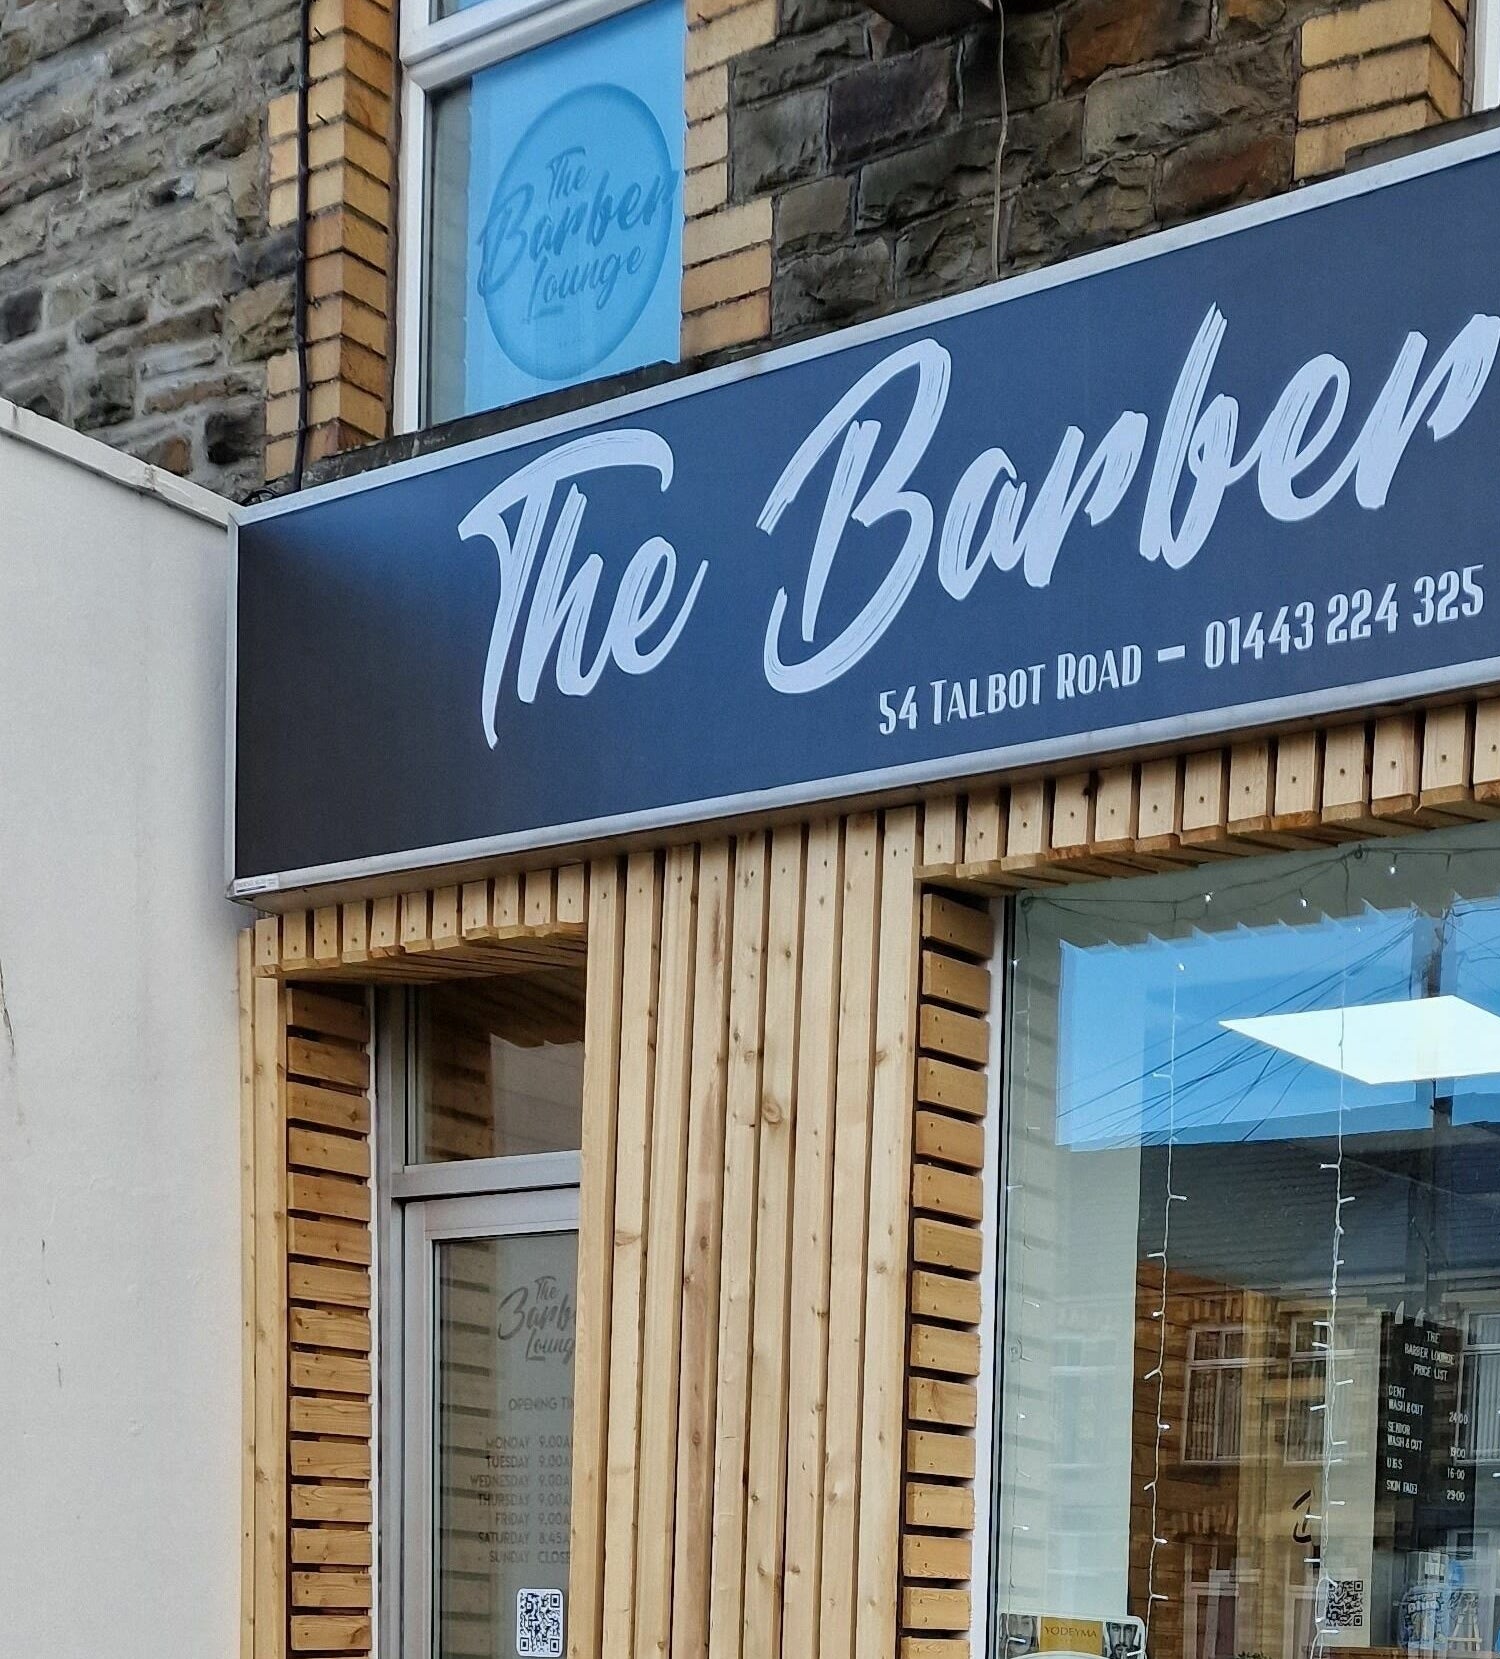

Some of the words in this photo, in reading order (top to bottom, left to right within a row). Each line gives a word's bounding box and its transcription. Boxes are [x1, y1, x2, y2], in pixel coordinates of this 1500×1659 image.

[545, 145, 592, 206] The
[476, 170, 680, 298] Barber
[522, 246, 647, 325] Lounge
[458, 429, 708, 750] The
[879, 685, 918, 735] 54
[930, 664, 1046, 725] TALBOT
[1057, 645, 1142, 700] ROAD
[1205, 601, 1315, 668] 01443
[1326, 583, 1399, 644] 224
[1413, 564, 1484, 626] 325
[534, 1275, 557, 1304] The
[498, 1287, 572, 1340] Barb
[525, 1328, 574, 1364] Loung
[1426, 1330, 1441, 1344] THE
[1433, 1367, 1448, 1381] LIST
[539, 1434, 571, 1449] 9.00A
[487, 1455, 529, 1468] TUESDAY
[537, 1551, 570, 1564] CLOSE
